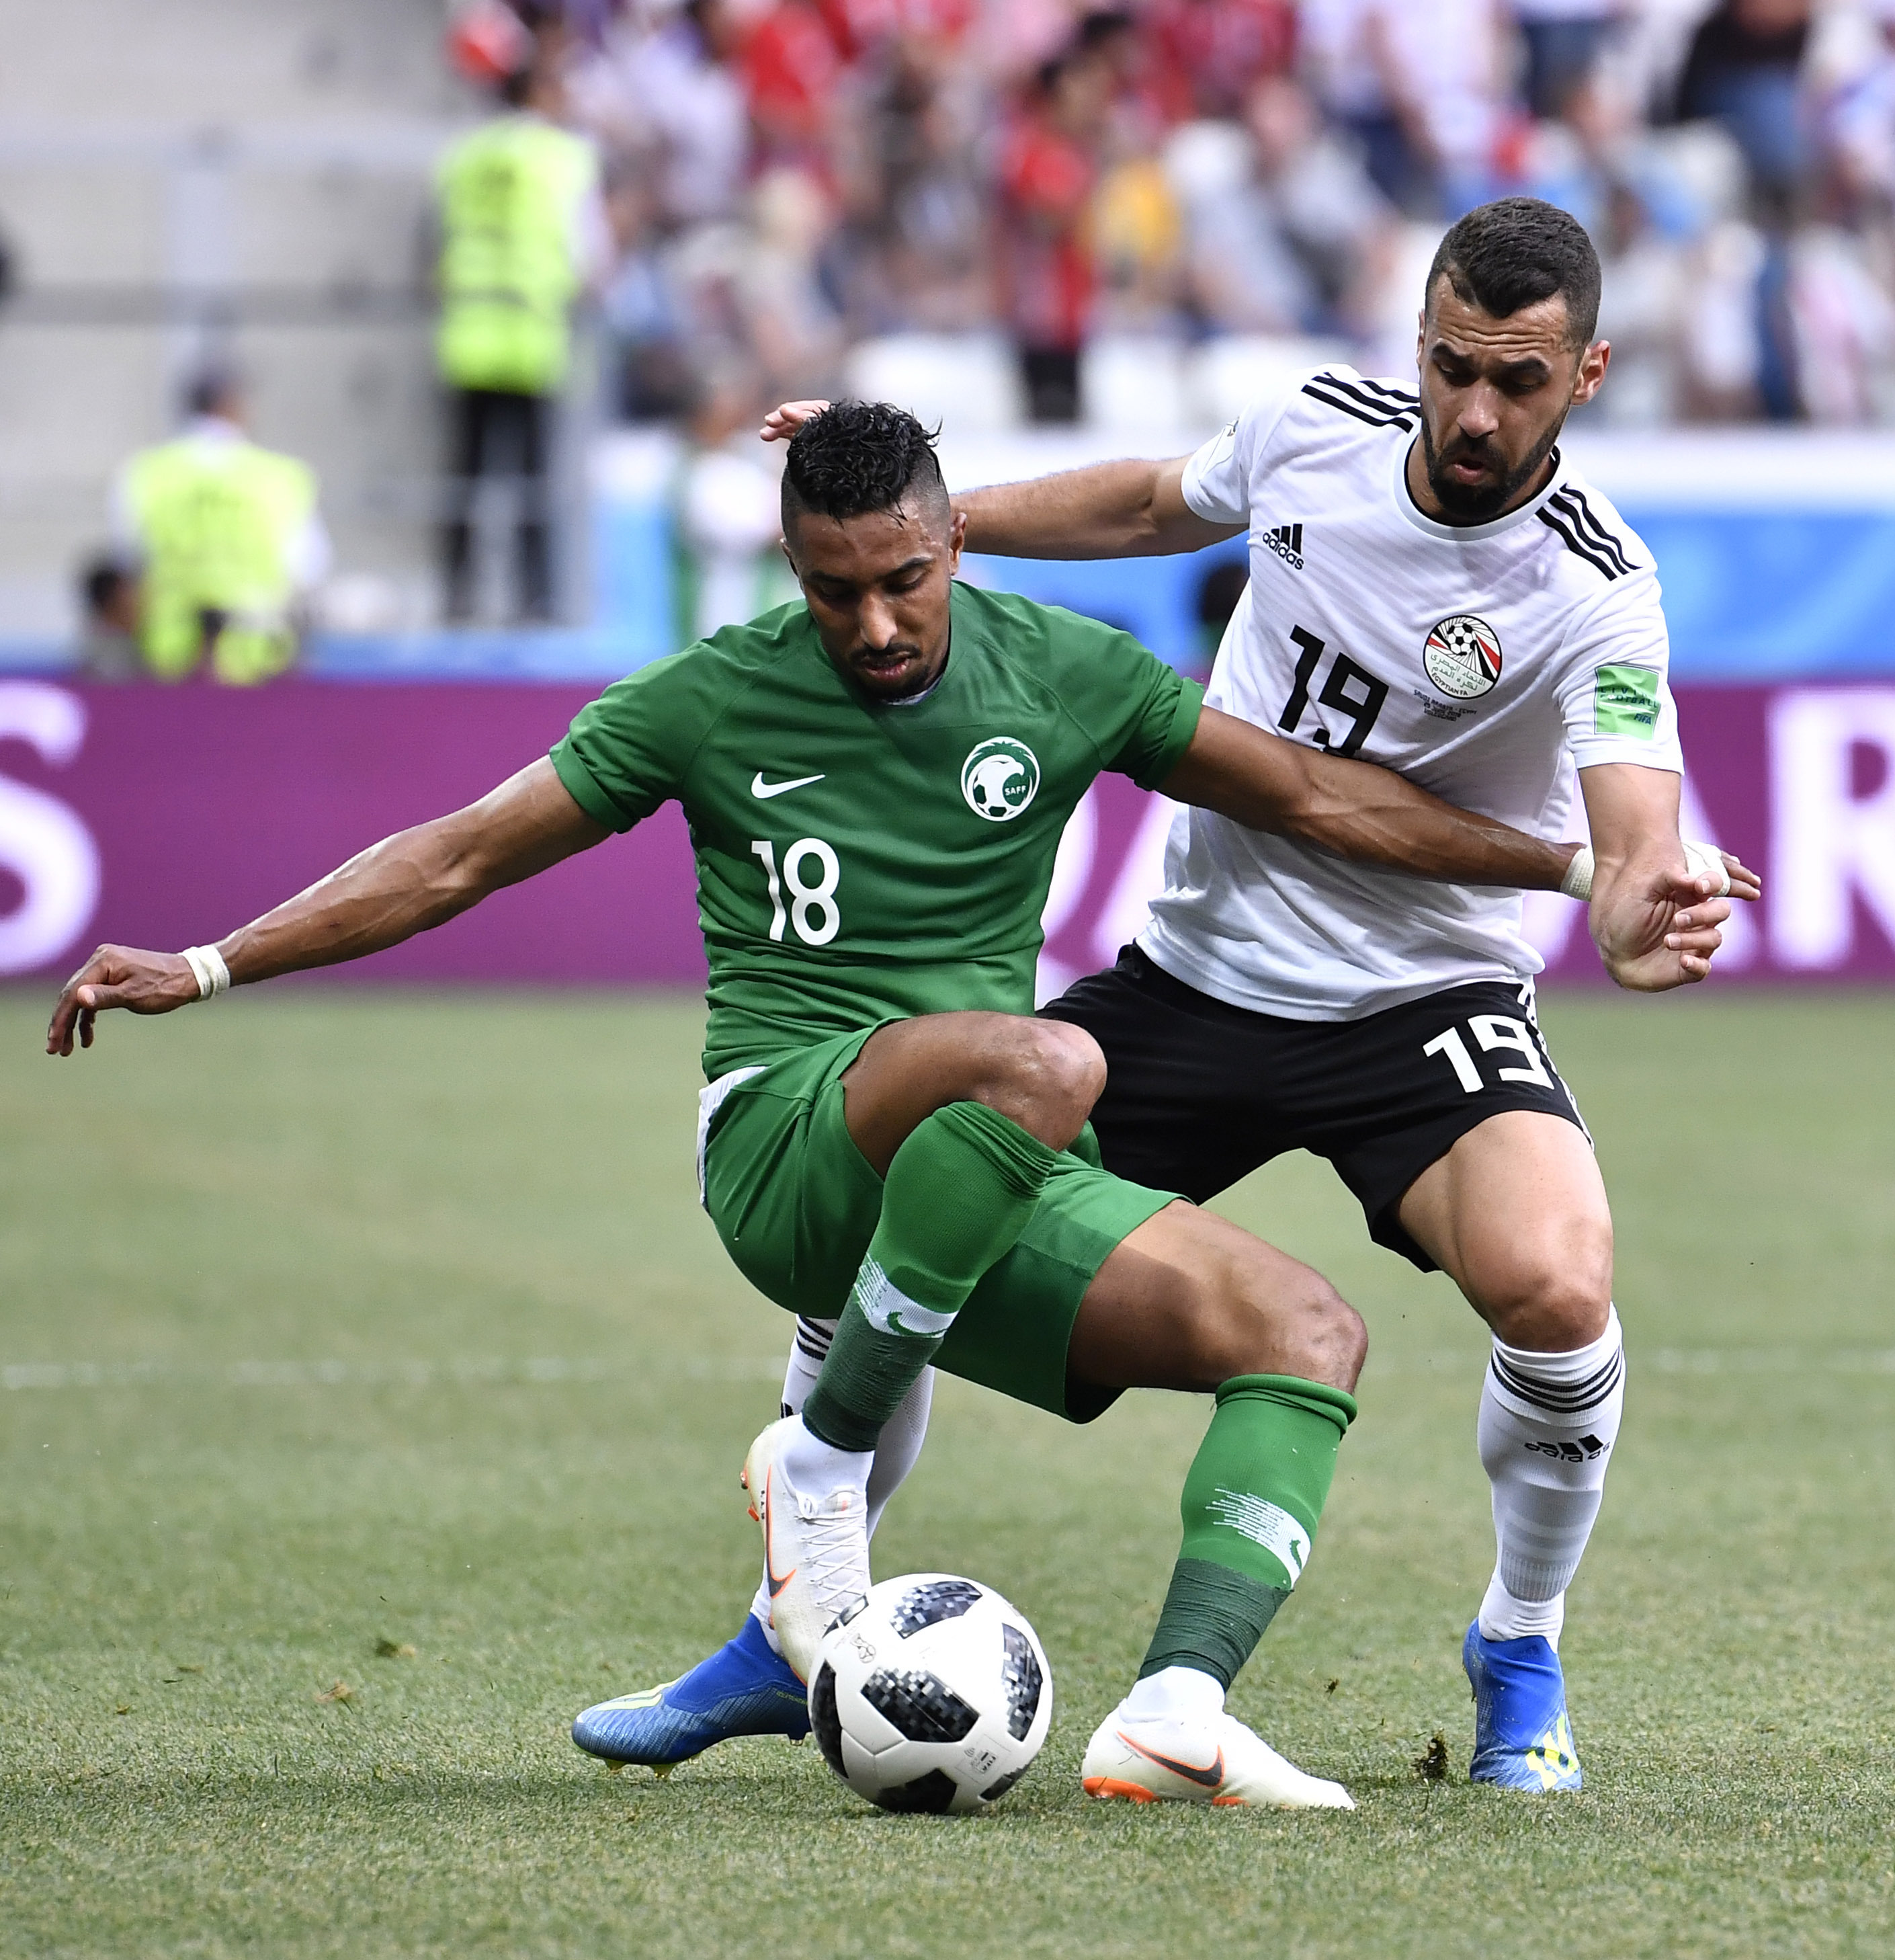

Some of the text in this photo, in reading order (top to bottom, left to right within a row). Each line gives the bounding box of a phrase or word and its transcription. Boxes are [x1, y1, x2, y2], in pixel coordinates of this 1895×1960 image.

[1263, 531, 1304, 570] adidas
[1277, 624, 1389, 758] 19
[1431, 672, 1459, 695] EGYPTIAN
[1634, 713, 1652, 725] FIFA
[1005, 785, 1026, 796] SAFF
[751, 838, 840, 946] 18
[1423, 1014, 1555, 1093] 19
[1523, 1440, 1610, 1463] adidas
